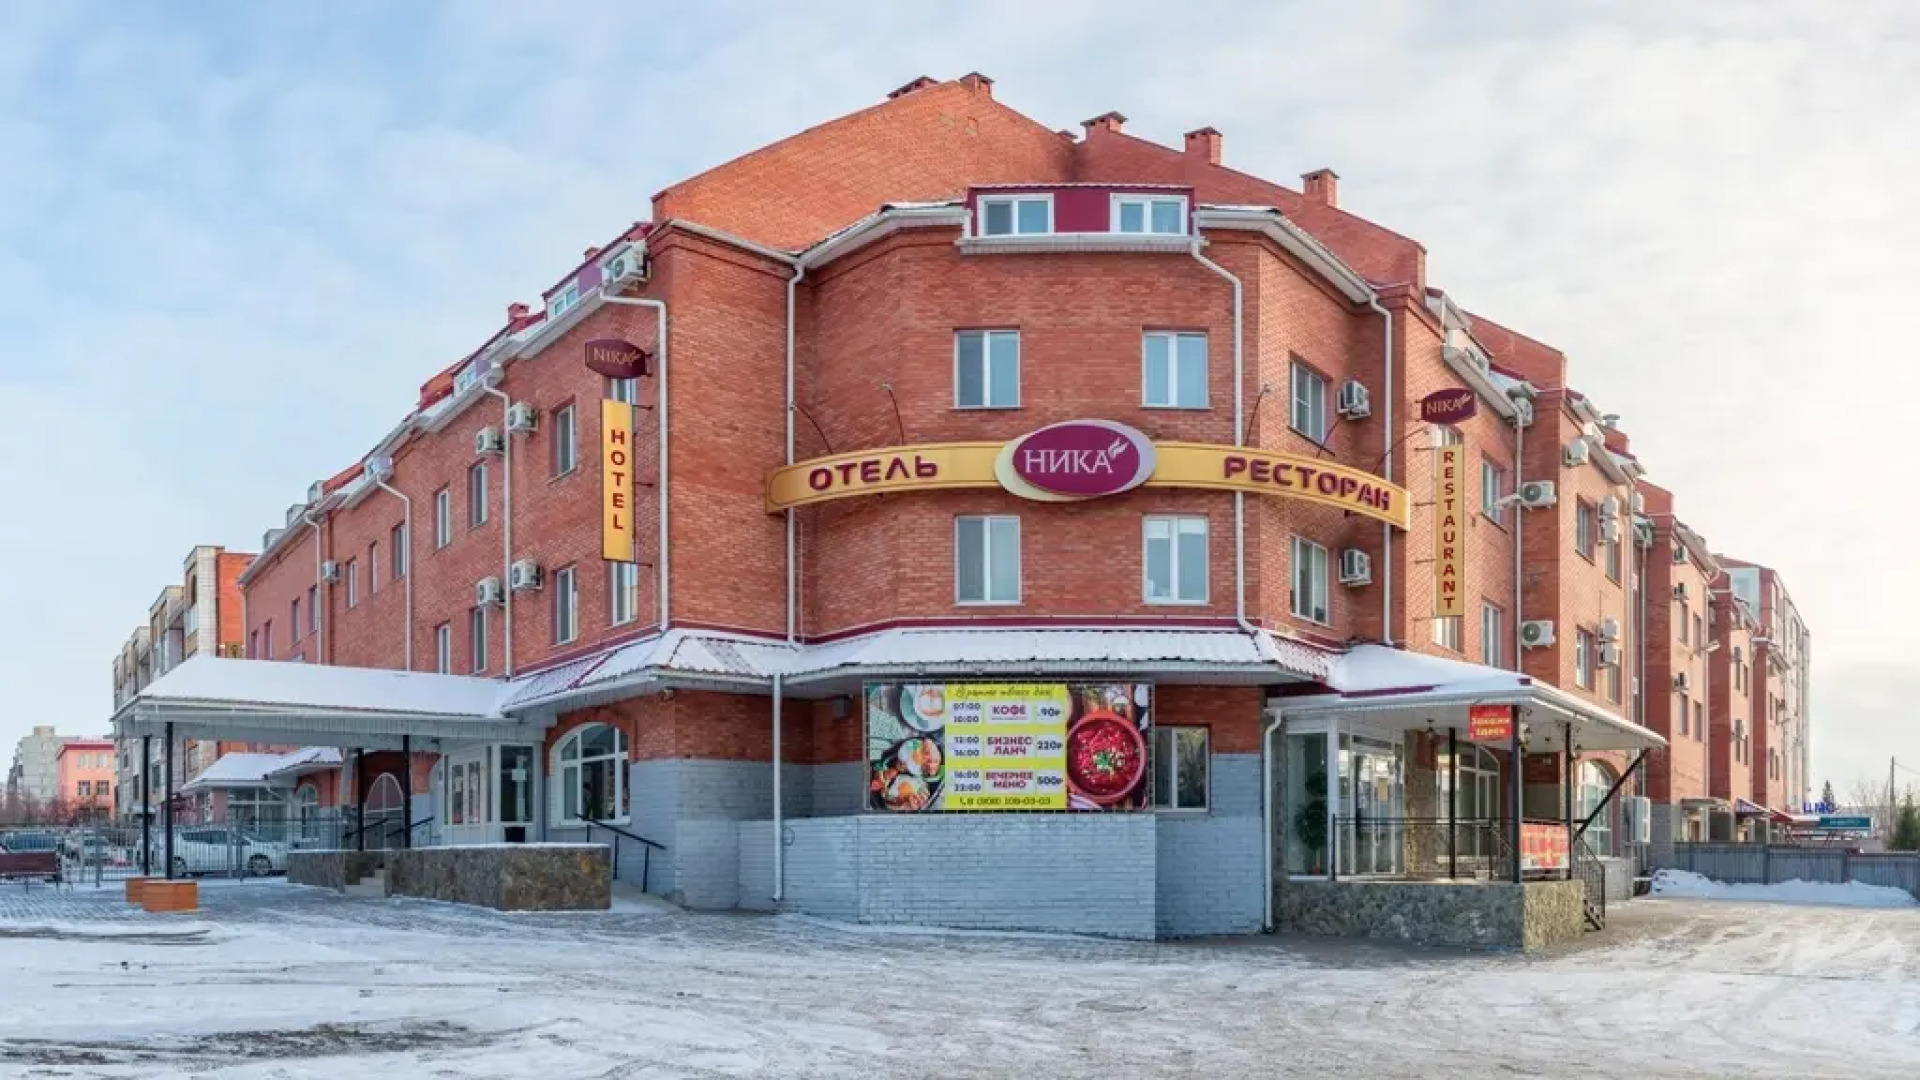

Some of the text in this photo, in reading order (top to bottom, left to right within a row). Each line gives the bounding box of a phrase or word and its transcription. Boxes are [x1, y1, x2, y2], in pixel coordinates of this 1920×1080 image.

[593, 348, 633, 364] NIKA
[1426, 399, 1462, 414] NIKA
[611, 428, 625, 530] HOTEL
[809, 449, 1391, 511] ОТЕЛЬ НИКА РЕСТОРАН
[1443, 451, 1456, 609] RESTAURANT
[992, 705, 1027, 715] КОФЕ
[987, 736, 1033, 745] БИЗНЕС
[993, 746, 1027, 755] ЛАНЧ
[985, 771, 1034, 780] ВЕЧЕРНЕЕ
[993, 780, 1027, 789] МЕНЮ
